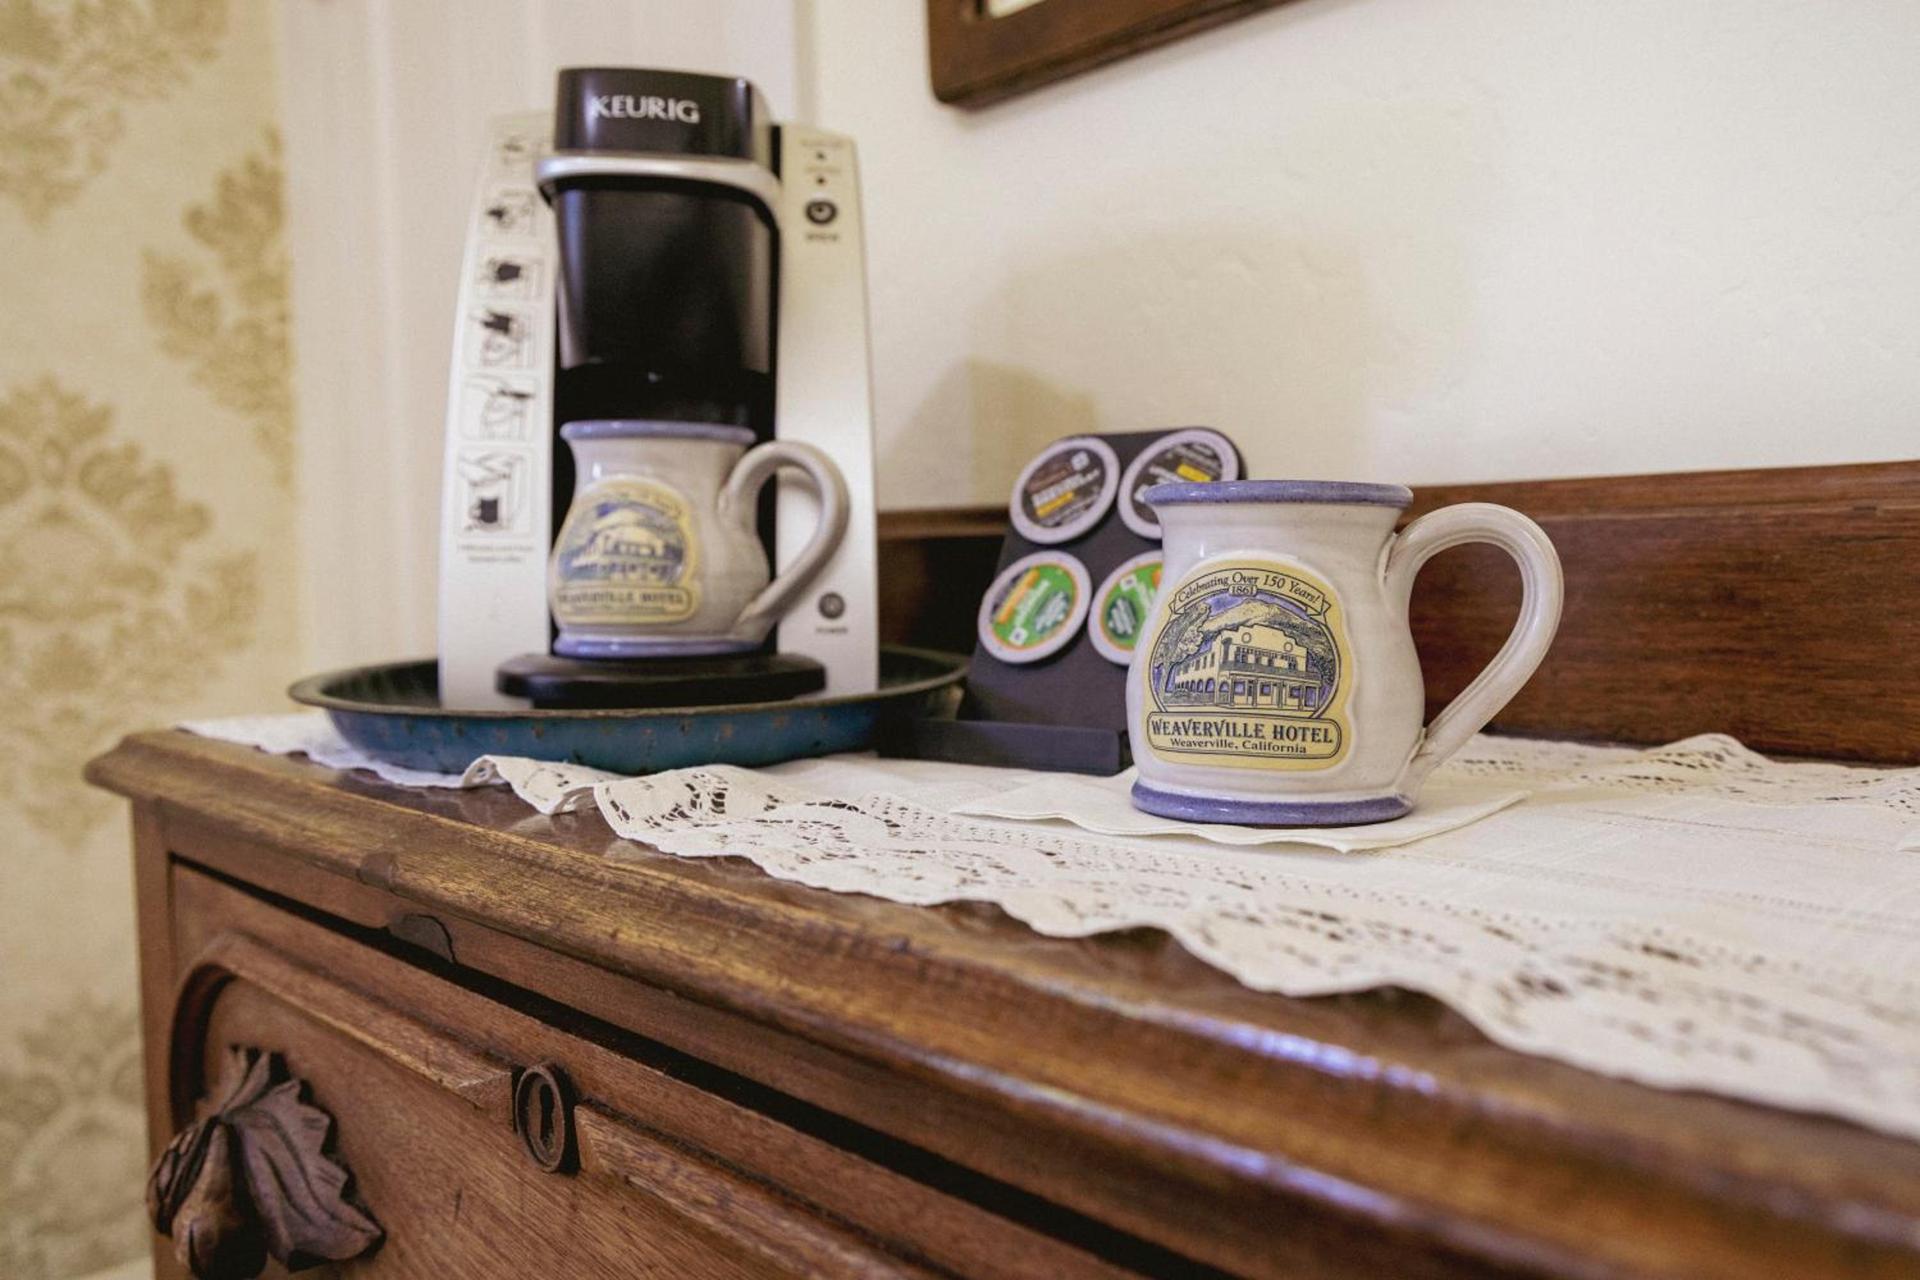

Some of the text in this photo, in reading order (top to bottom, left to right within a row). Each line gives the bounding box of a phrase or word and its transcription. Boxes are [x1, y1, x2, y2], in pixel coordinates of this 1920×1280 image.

[592, 95, 700, 124] KEURIG
[1178, 572, 1321, 603] Celebrating Over 150 Years!
[1231, 585, 1254, 595] 1861
[1151, 718, 1333, 743] WEAVERVILLE HOTEL
[1170, 738, 1307, 754] Weaverville, California
